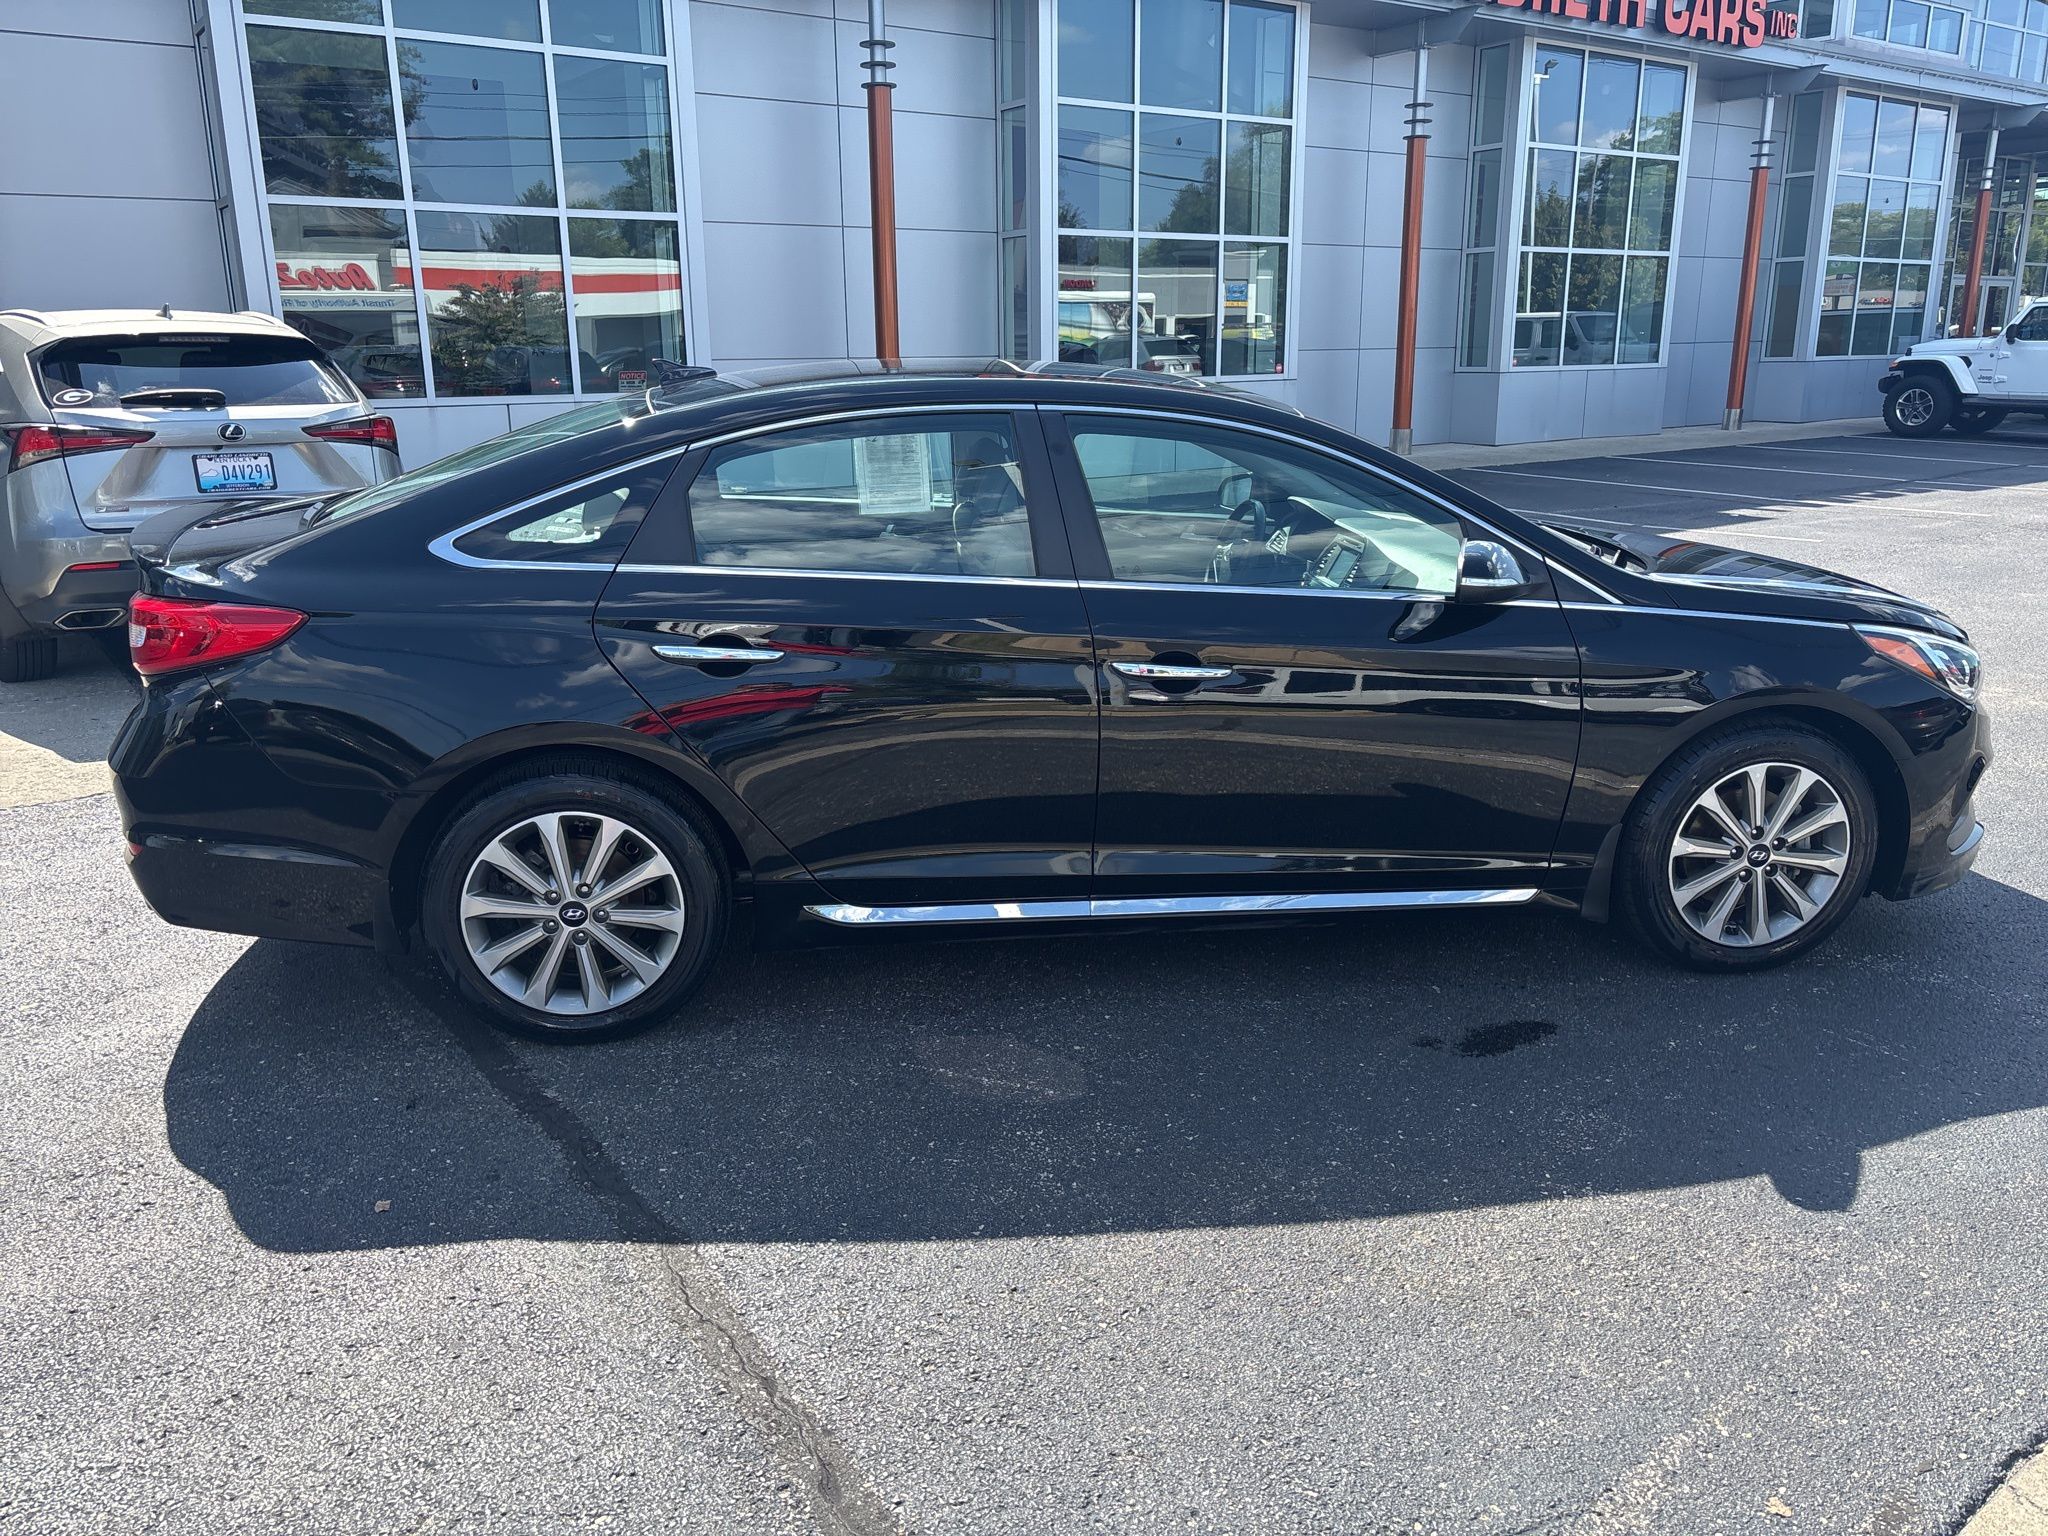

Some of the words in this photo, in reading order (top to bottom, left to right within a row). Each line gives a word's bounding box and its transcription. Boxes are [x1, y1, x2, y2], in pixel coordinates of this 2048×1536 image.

[1664, 0, 1768, 48] CARS
[1770, 9, 1799, 39] INC
[221, 463, 271, 481] D4V291
